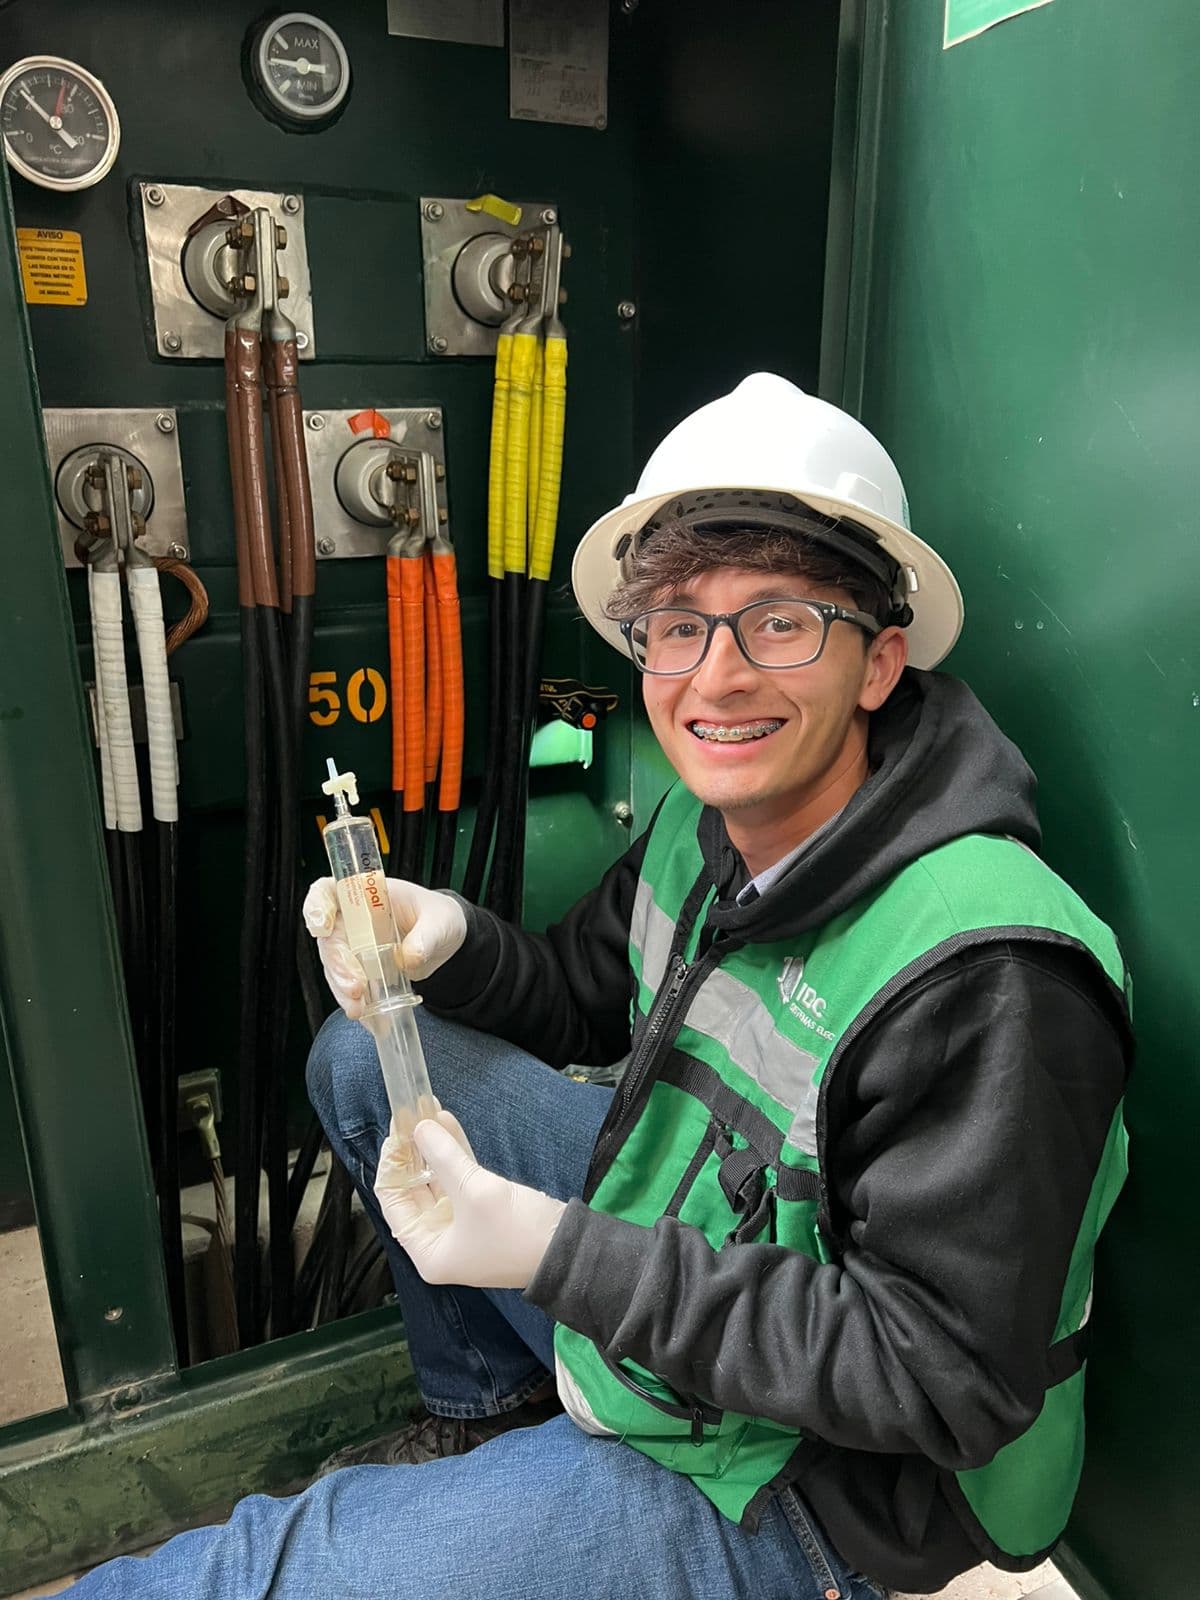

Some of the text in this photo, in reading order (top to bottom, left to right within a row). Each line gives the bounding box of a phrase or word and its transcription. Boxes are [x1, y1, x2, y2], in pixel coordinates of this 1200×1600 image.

[294, 37, 319, 50] MAX
[296, 80, 318, 92] MIN
[37, 230, 63, 240] AVISO
[308, 666, 388, 727] 50
[796, 982, 826, 1018] IDC
